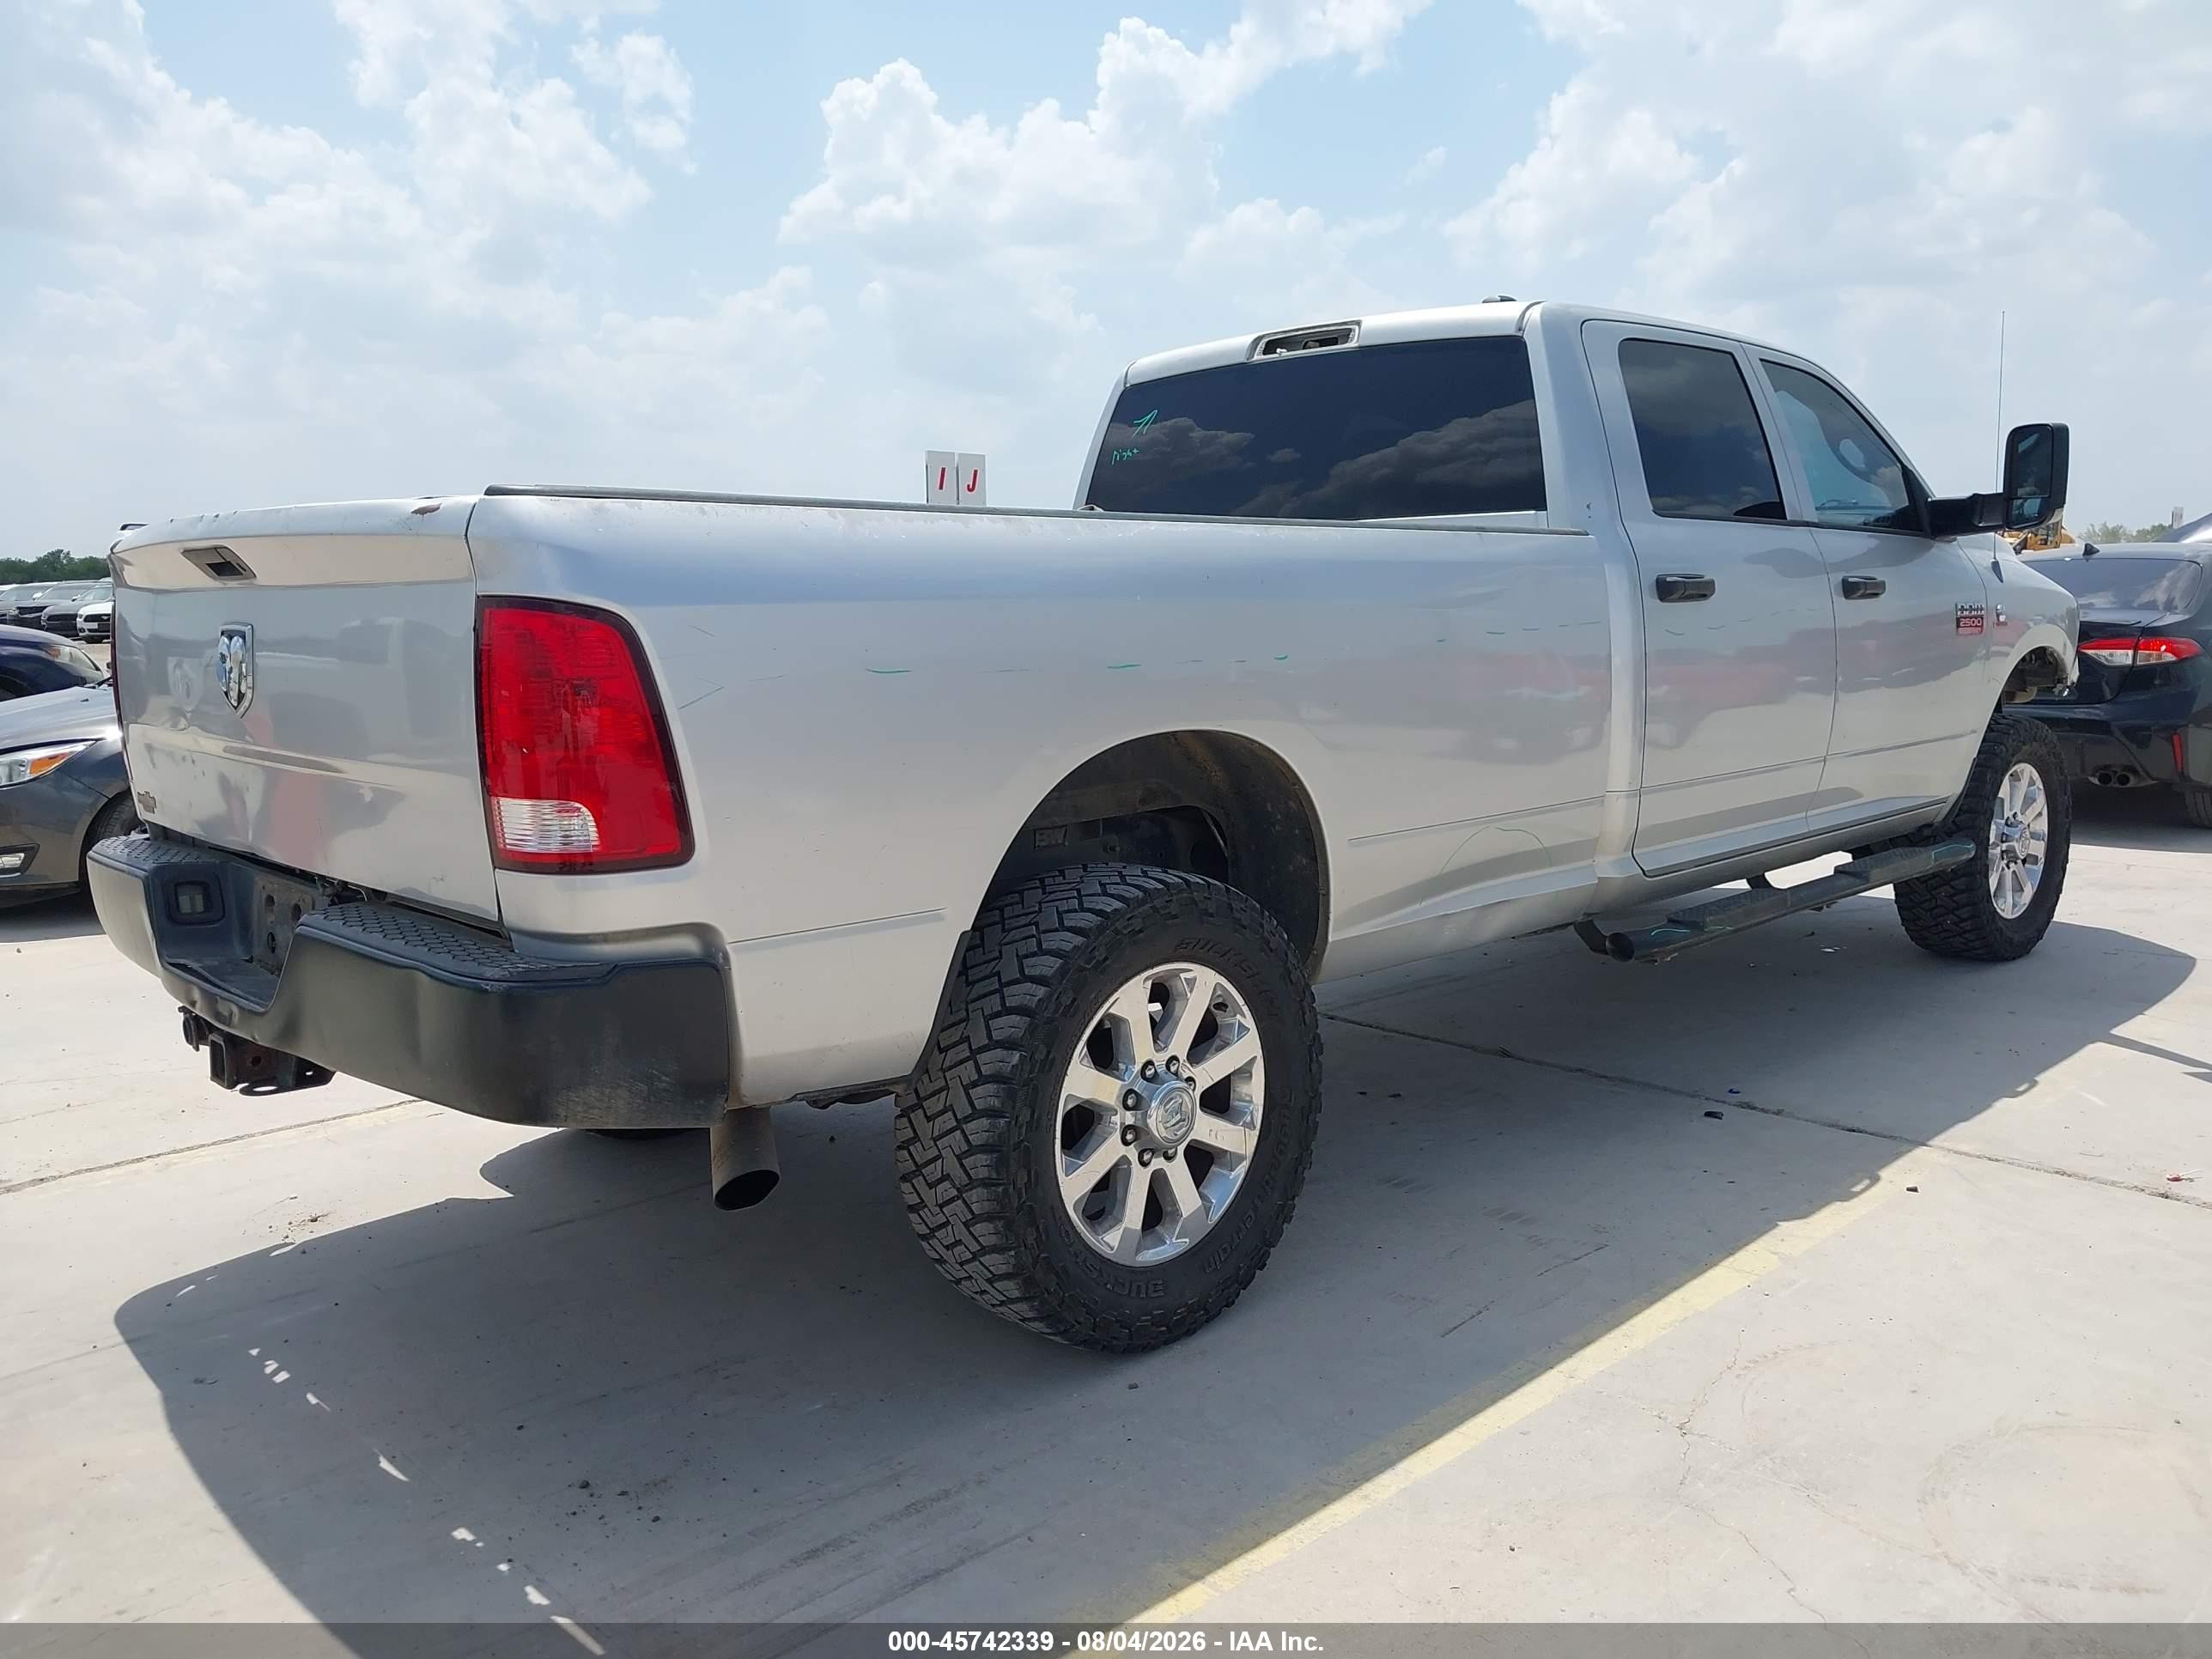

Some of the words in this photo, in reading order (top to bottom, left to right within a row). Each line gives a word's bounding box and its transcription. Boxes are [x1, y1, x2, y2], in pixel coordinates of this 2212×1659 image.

[938, 466, 946, 490] I
[966, 468, 978, 493] J
[1960, 617, 1983, 627] 2500
